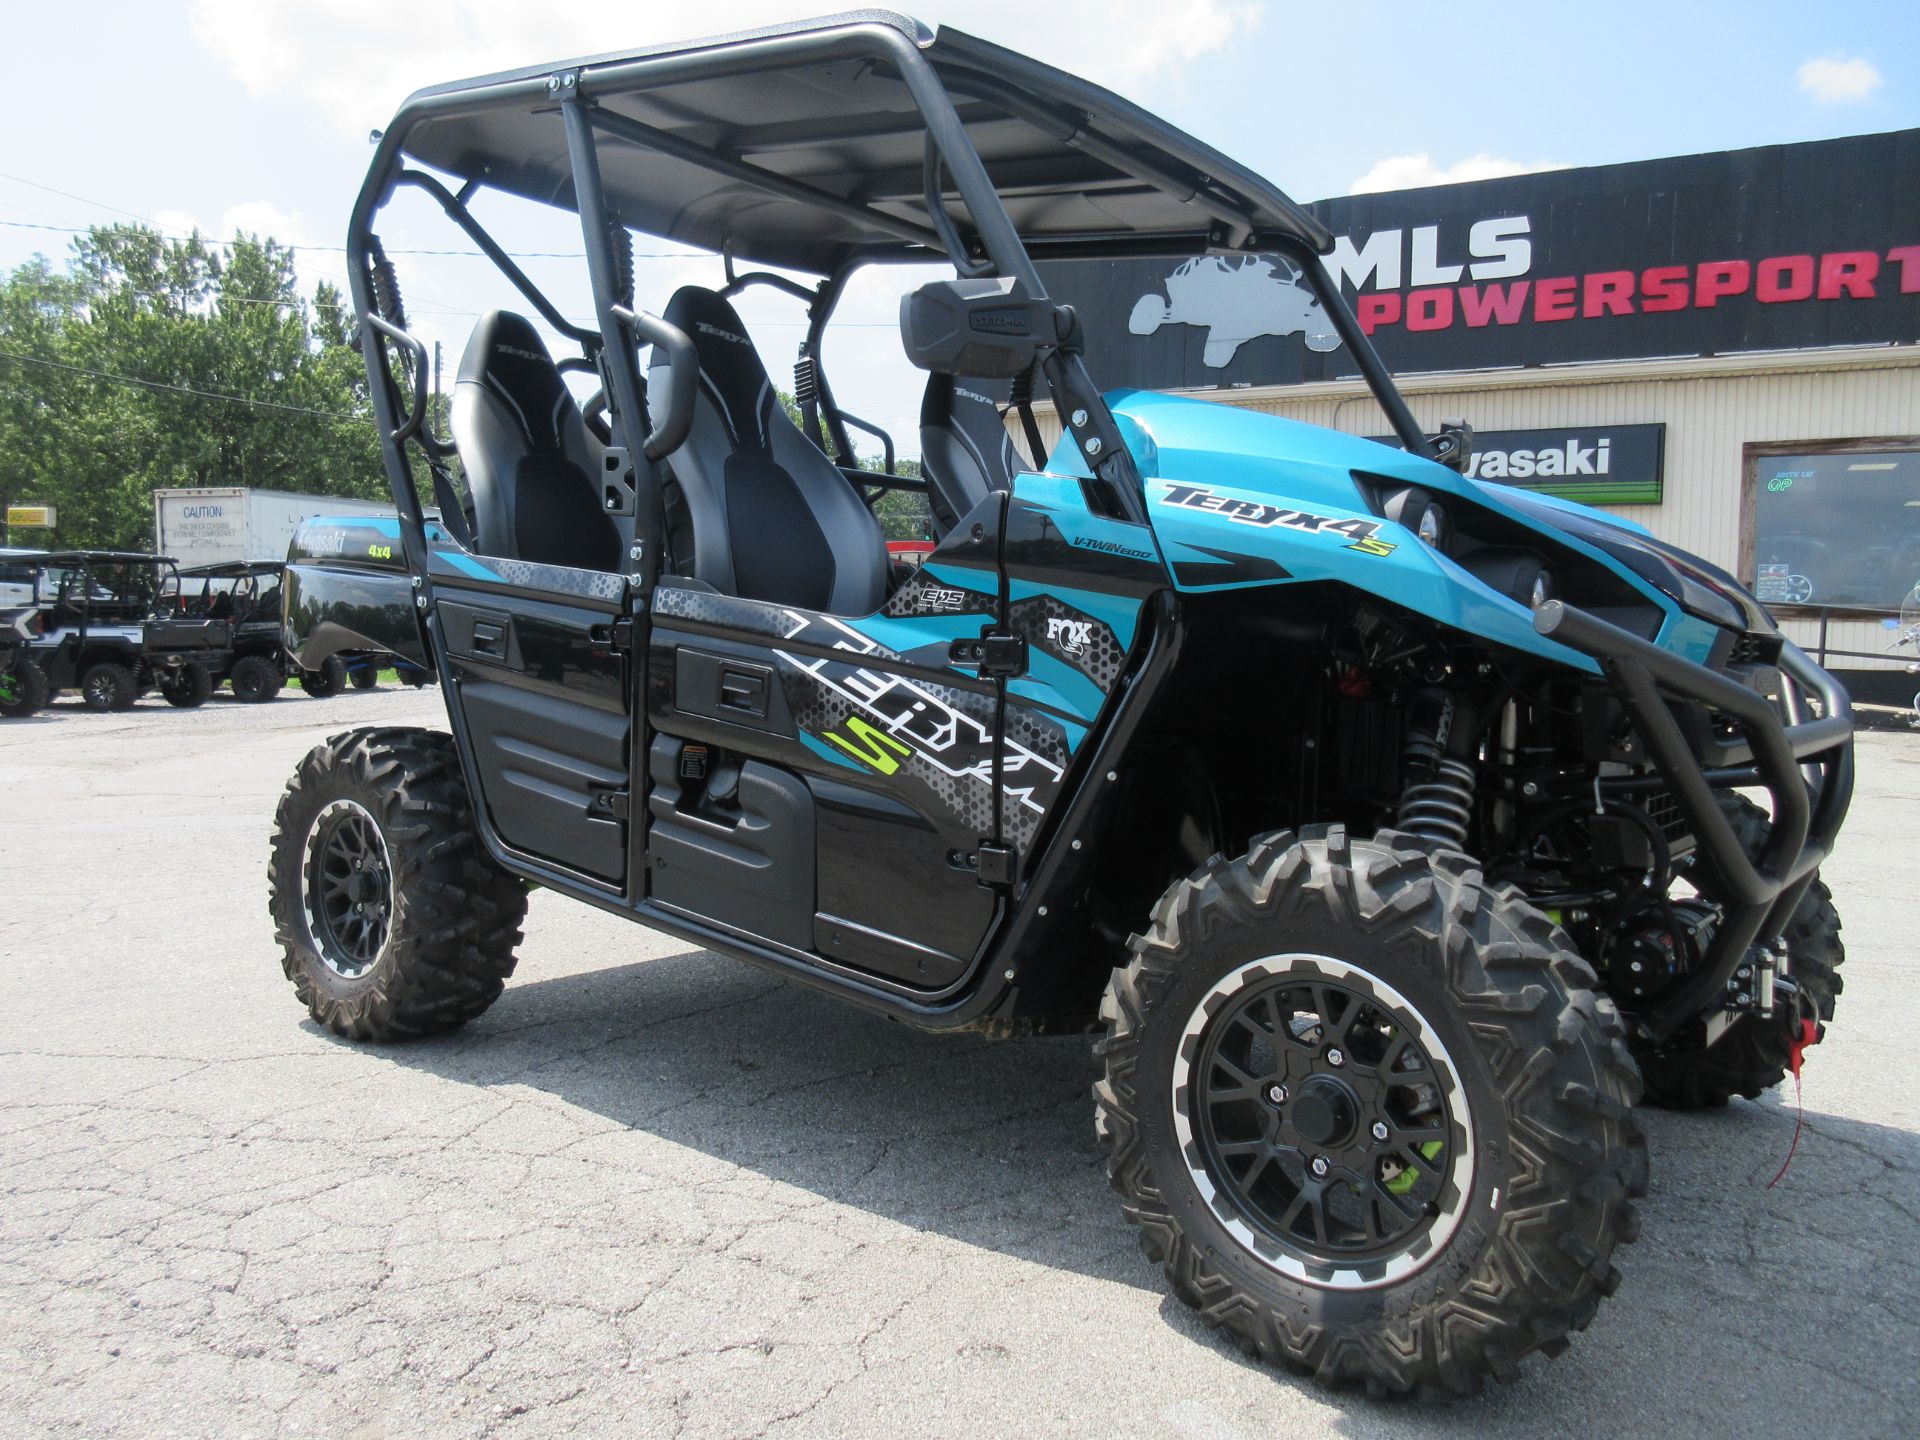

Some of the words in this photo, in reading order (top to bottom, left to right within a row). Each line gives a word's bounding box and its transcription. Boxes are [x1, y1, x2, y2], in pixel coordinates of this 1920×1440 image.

[1319, 216, 1532, 294] MLS
[1463, 438, 1611, 478] asaki
[297, 529, 346, 553] Kawasaki
[920, 588, 966, 606] EPS
[1047, 618, 1093, 656] FOX
